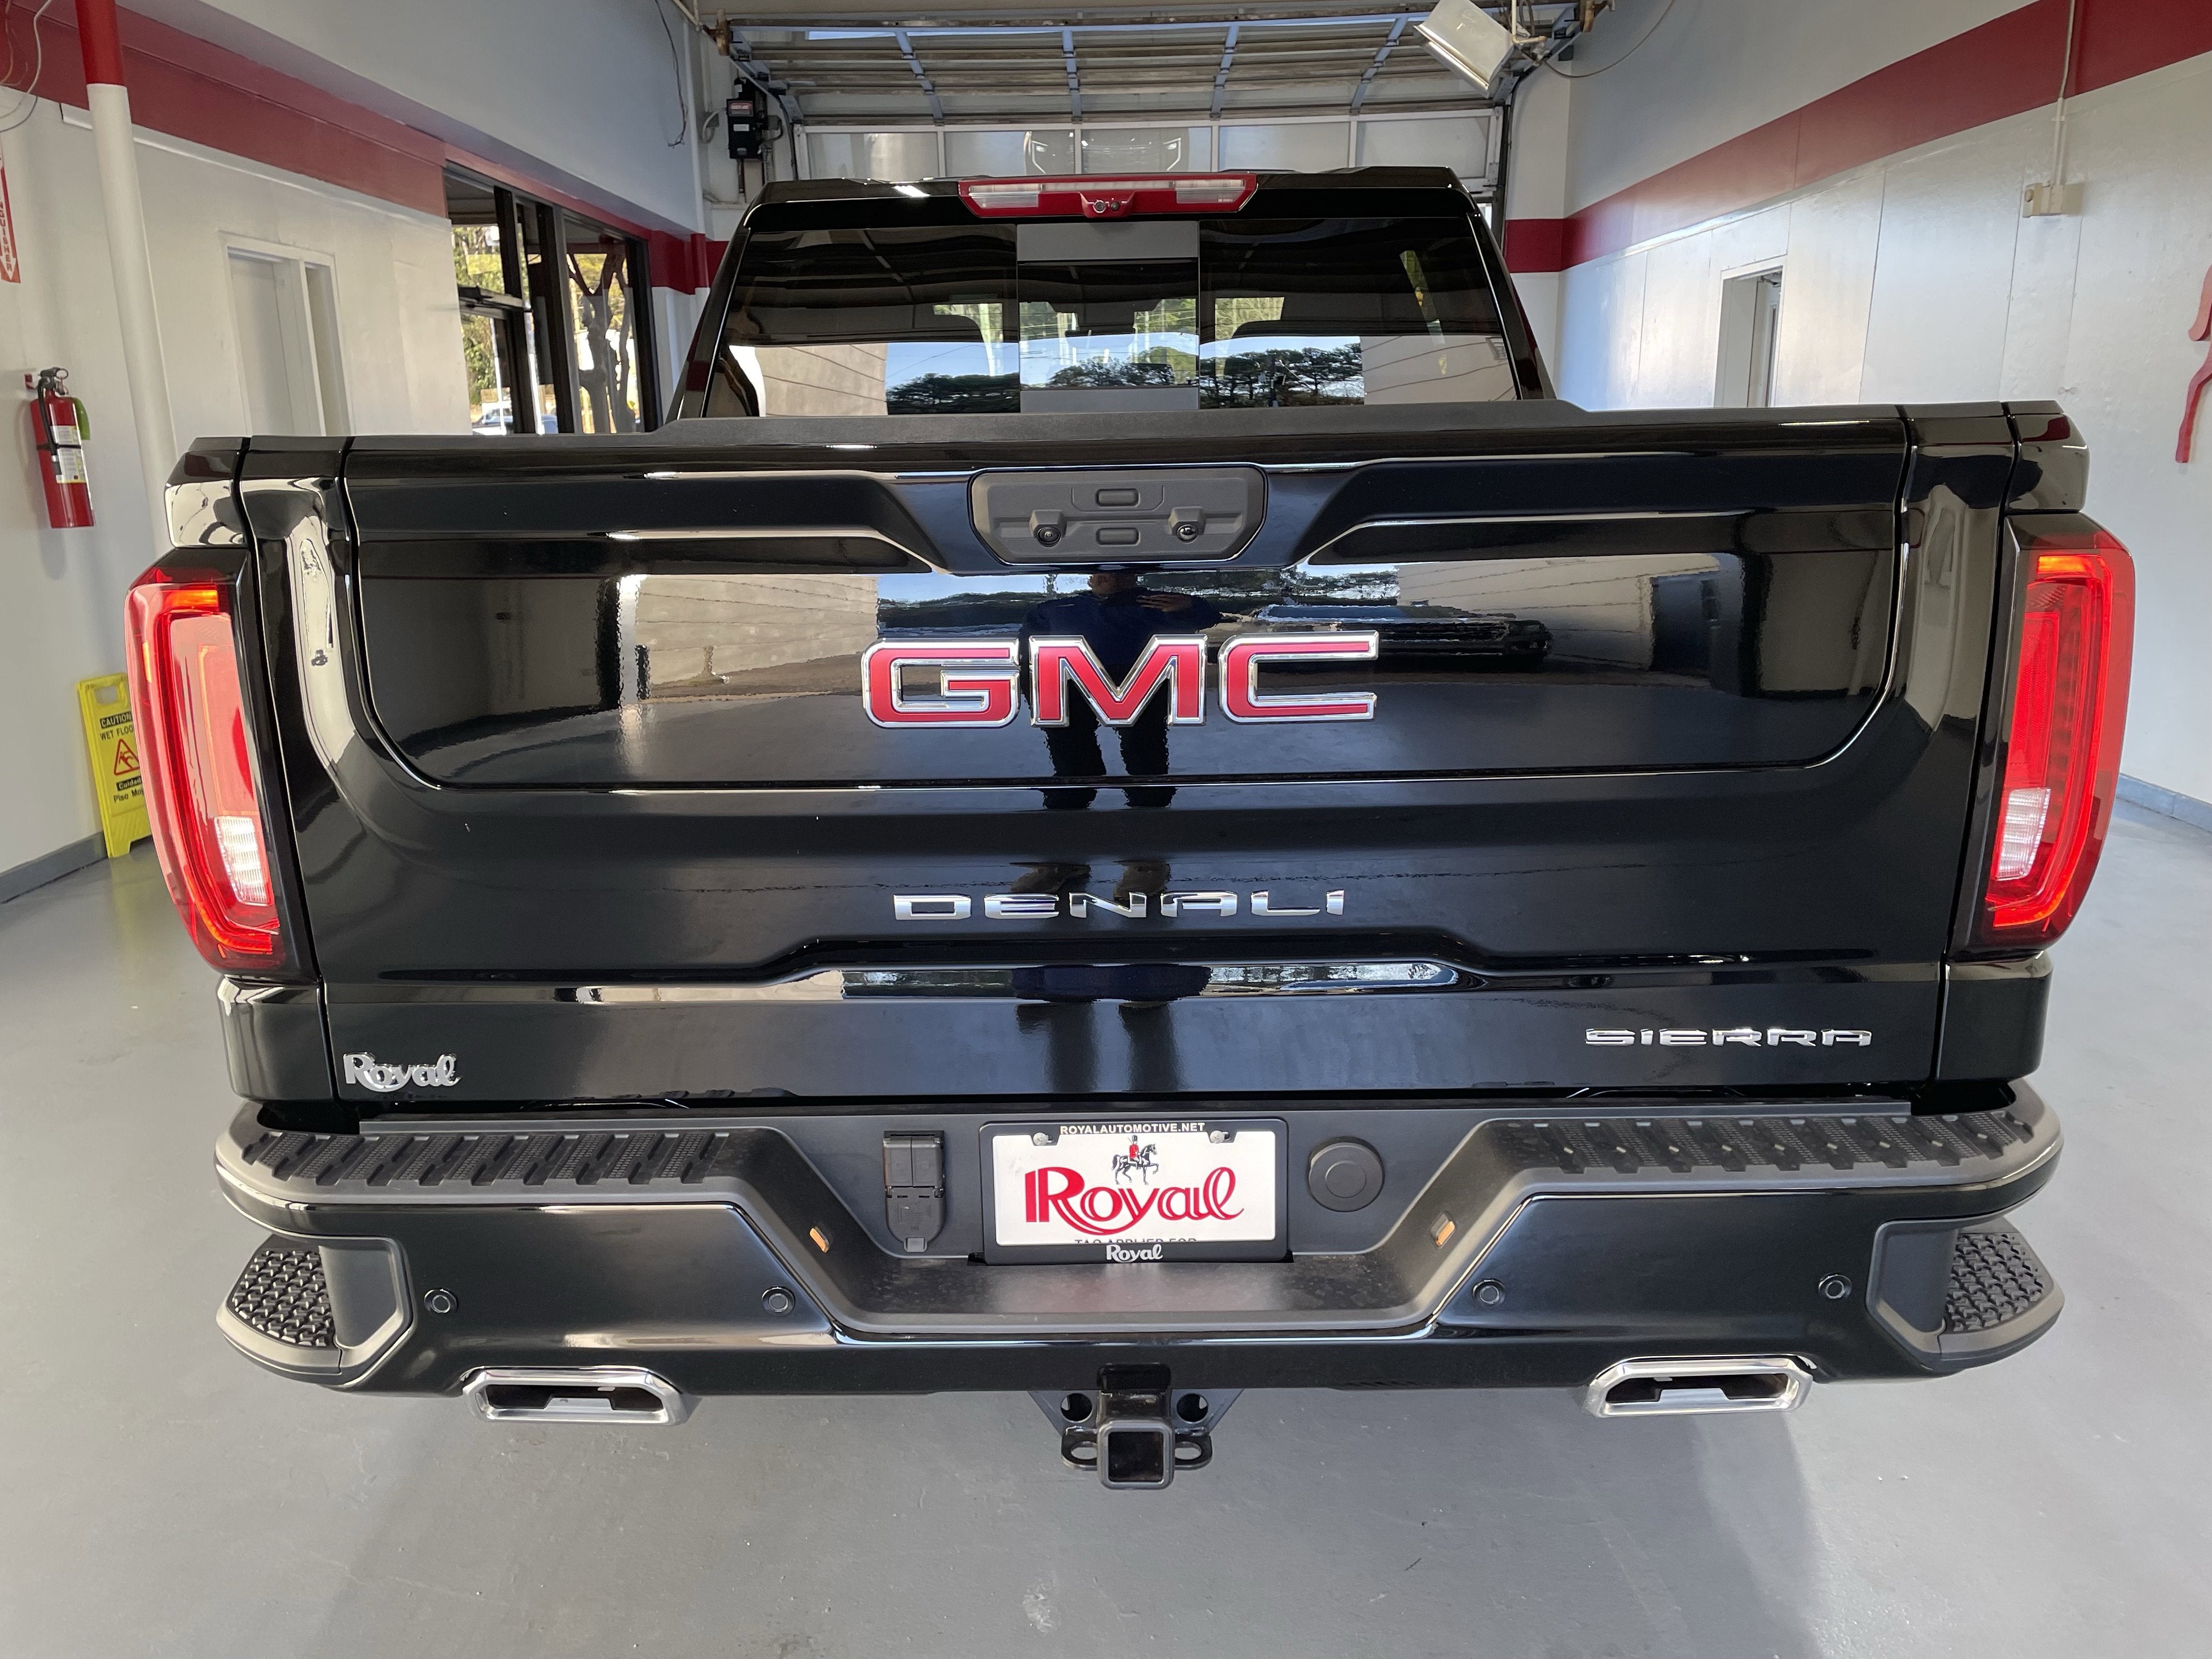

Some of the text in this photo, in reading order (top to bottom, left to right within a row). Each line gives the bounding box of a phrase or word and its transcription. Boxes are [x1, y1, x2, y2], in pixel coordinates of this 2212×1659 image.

[0, 201, 13, 272] NGUISHER
[861, 631, 1380, 729] GMC
[100, 712, 132, 728] CAUTION
[100, 724, 133, 741] WET FLOO
[118, 777, 142, 789] Cuidad
[114, 787, 144, 803] Piso Moj
[893, 889, 1345, 921] DENALI
[1585, 1028, 1872, 1047] SIERRA
[343, 1051, 463, 1092] Royal
[1060, 1122, 1205, 1135] ROYALAUTOMOTIVE.NET
[1025, 1166, 1244, 1236] Royal
[1106, 1244, 1164, 1263] Royal
